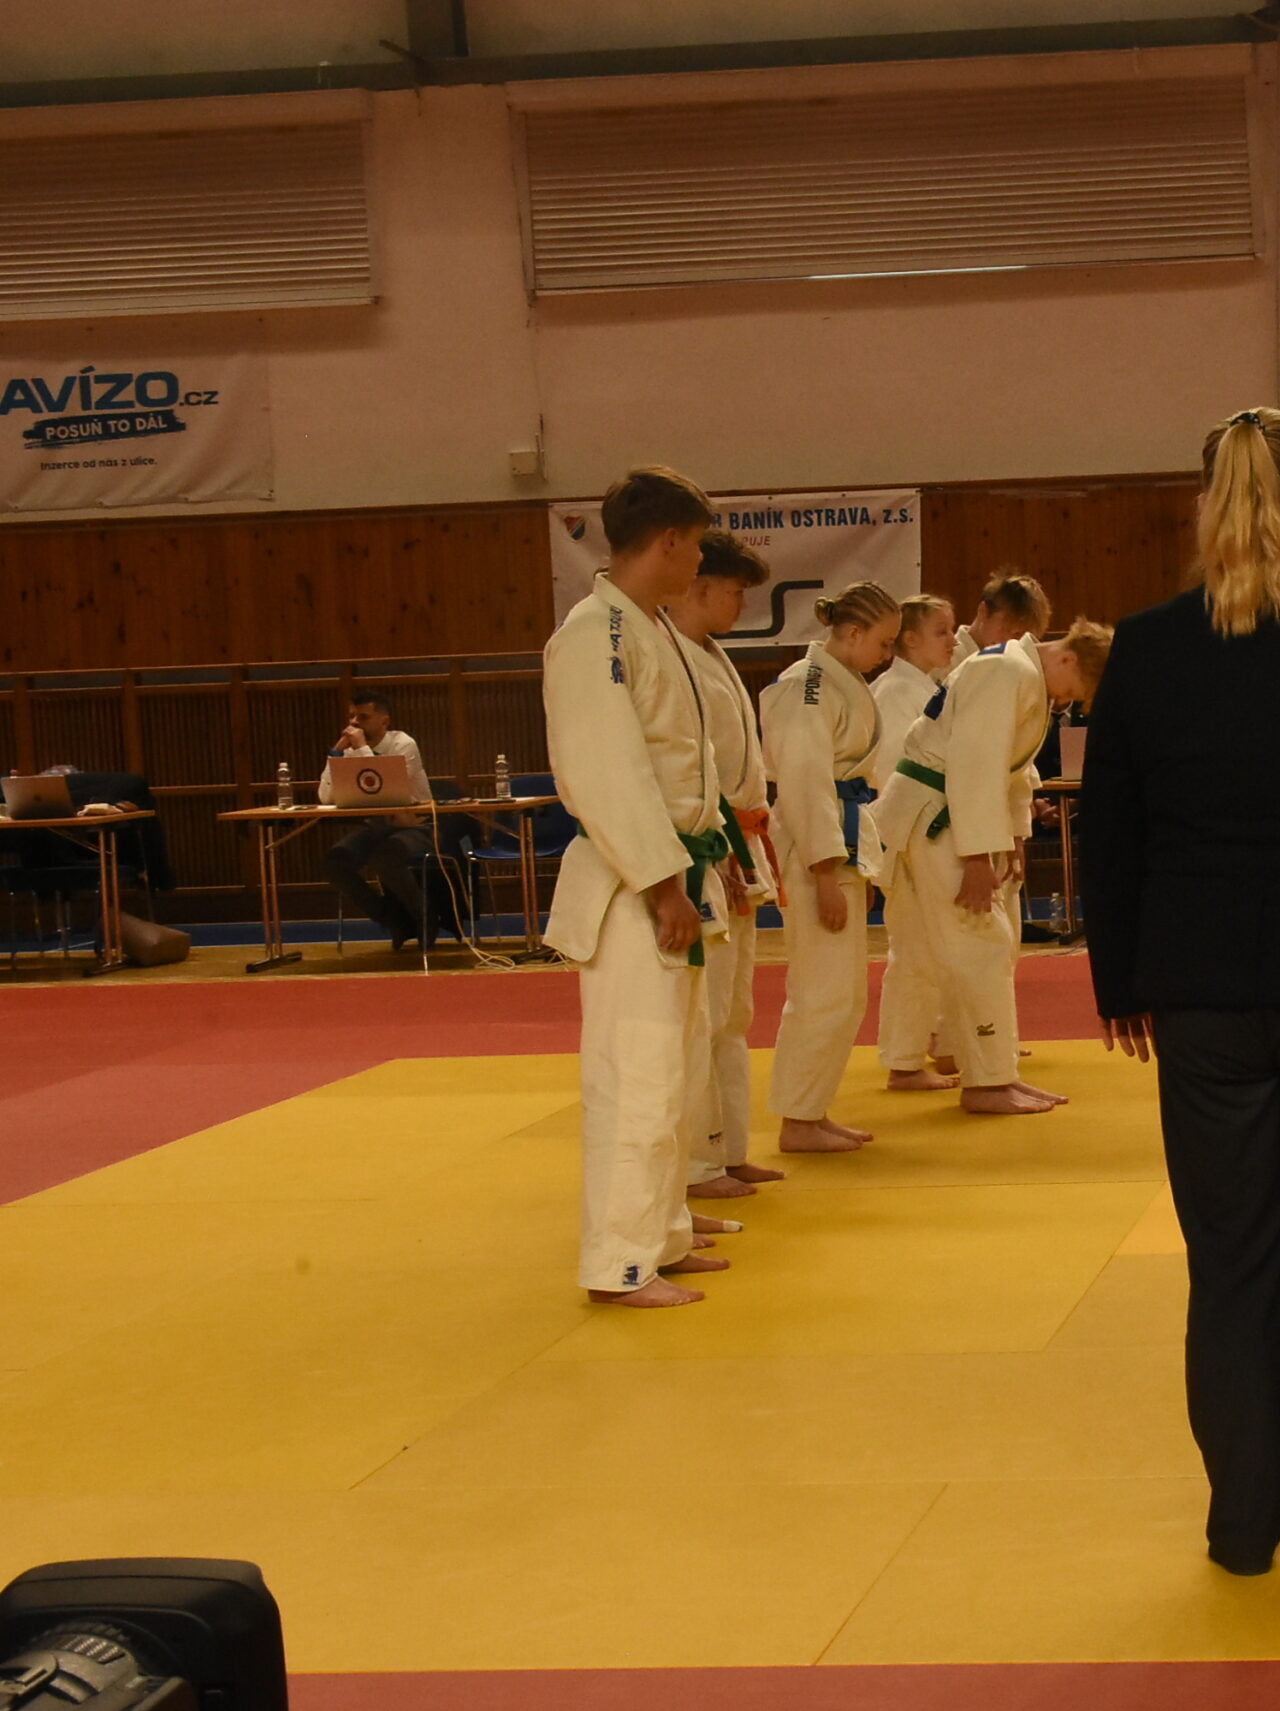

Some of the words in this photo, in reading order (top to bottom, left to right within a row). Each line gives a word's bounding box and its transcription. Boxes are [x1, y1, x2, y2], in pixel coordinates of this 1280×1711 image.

[46, 418, 102, 440] POSUŇ
[108, 419, 131, 433] TO
[136, 413, 168, 431] DÁL
[41, 459, 79, 471] Inzerce
[83, 457, 96, 469] od
[98, 456, 118, 467] nás
[121, 458, 128, 467] z
[130, 455, 158, 467] ulice.
[729, 506, 785, 531] BANÍK
[791, 506, 876, 527] OSTRAVA,
[883, 508, 914, 524] z.s.
